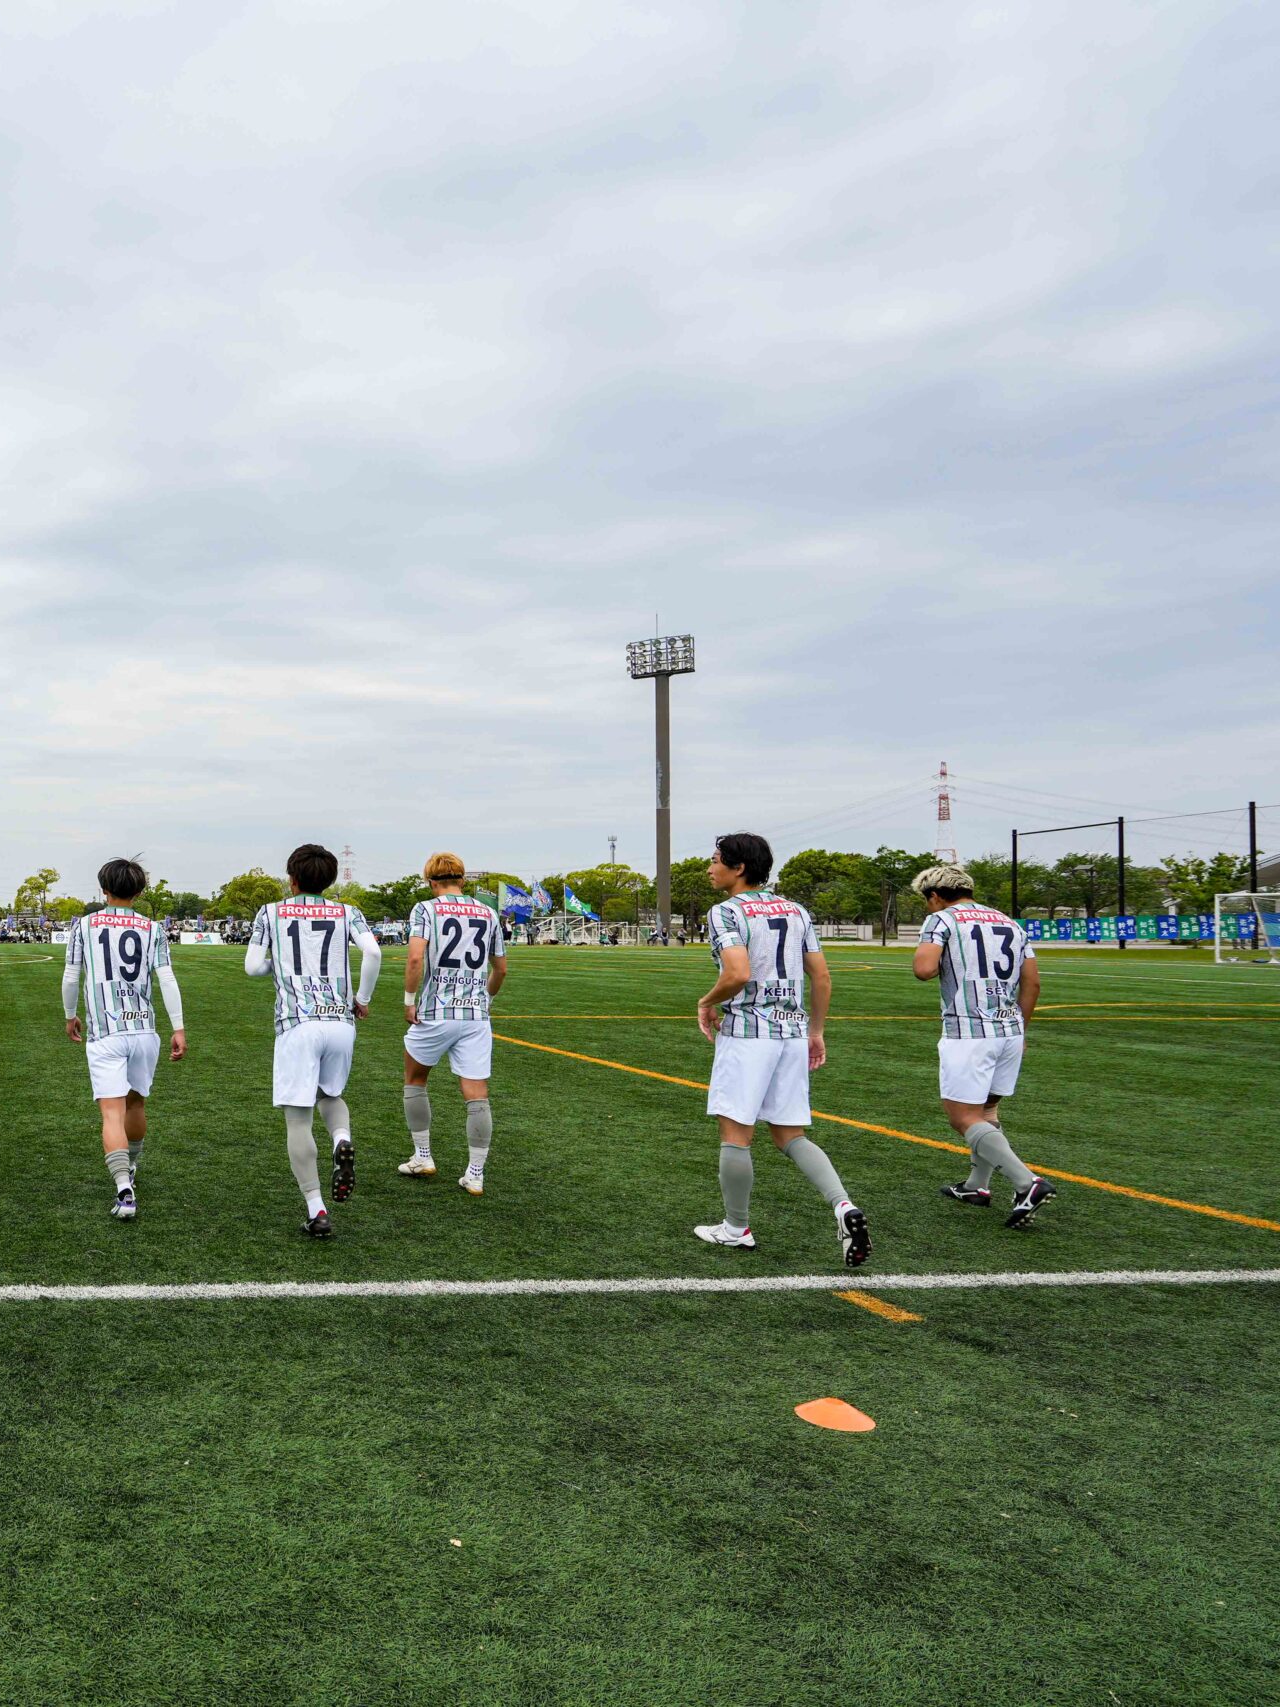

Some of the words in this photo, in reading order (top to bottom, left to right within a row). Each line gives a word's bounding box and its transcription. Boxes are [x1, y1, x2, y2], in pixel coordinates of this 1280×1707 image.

[279, 906, 342, 916] FRONTIER
[436, 904, 488, 916] FRONTIER
[954, 910, 1010, 922] FRONTIE
[91, 915, 148, 928] FRONTIER
[287, 920, 335, 976] 17
[438, 918, 488, 970] 23
[767, 918, 788, 980] 7
[99, 928, 142, 982] 19
[971, 924, 1014, 980] 13
[432, 976, 486, 986] NISHIGUCHI
[117, 989, 134, 997] IBU
[764, 988, 796, 997] KEITA
